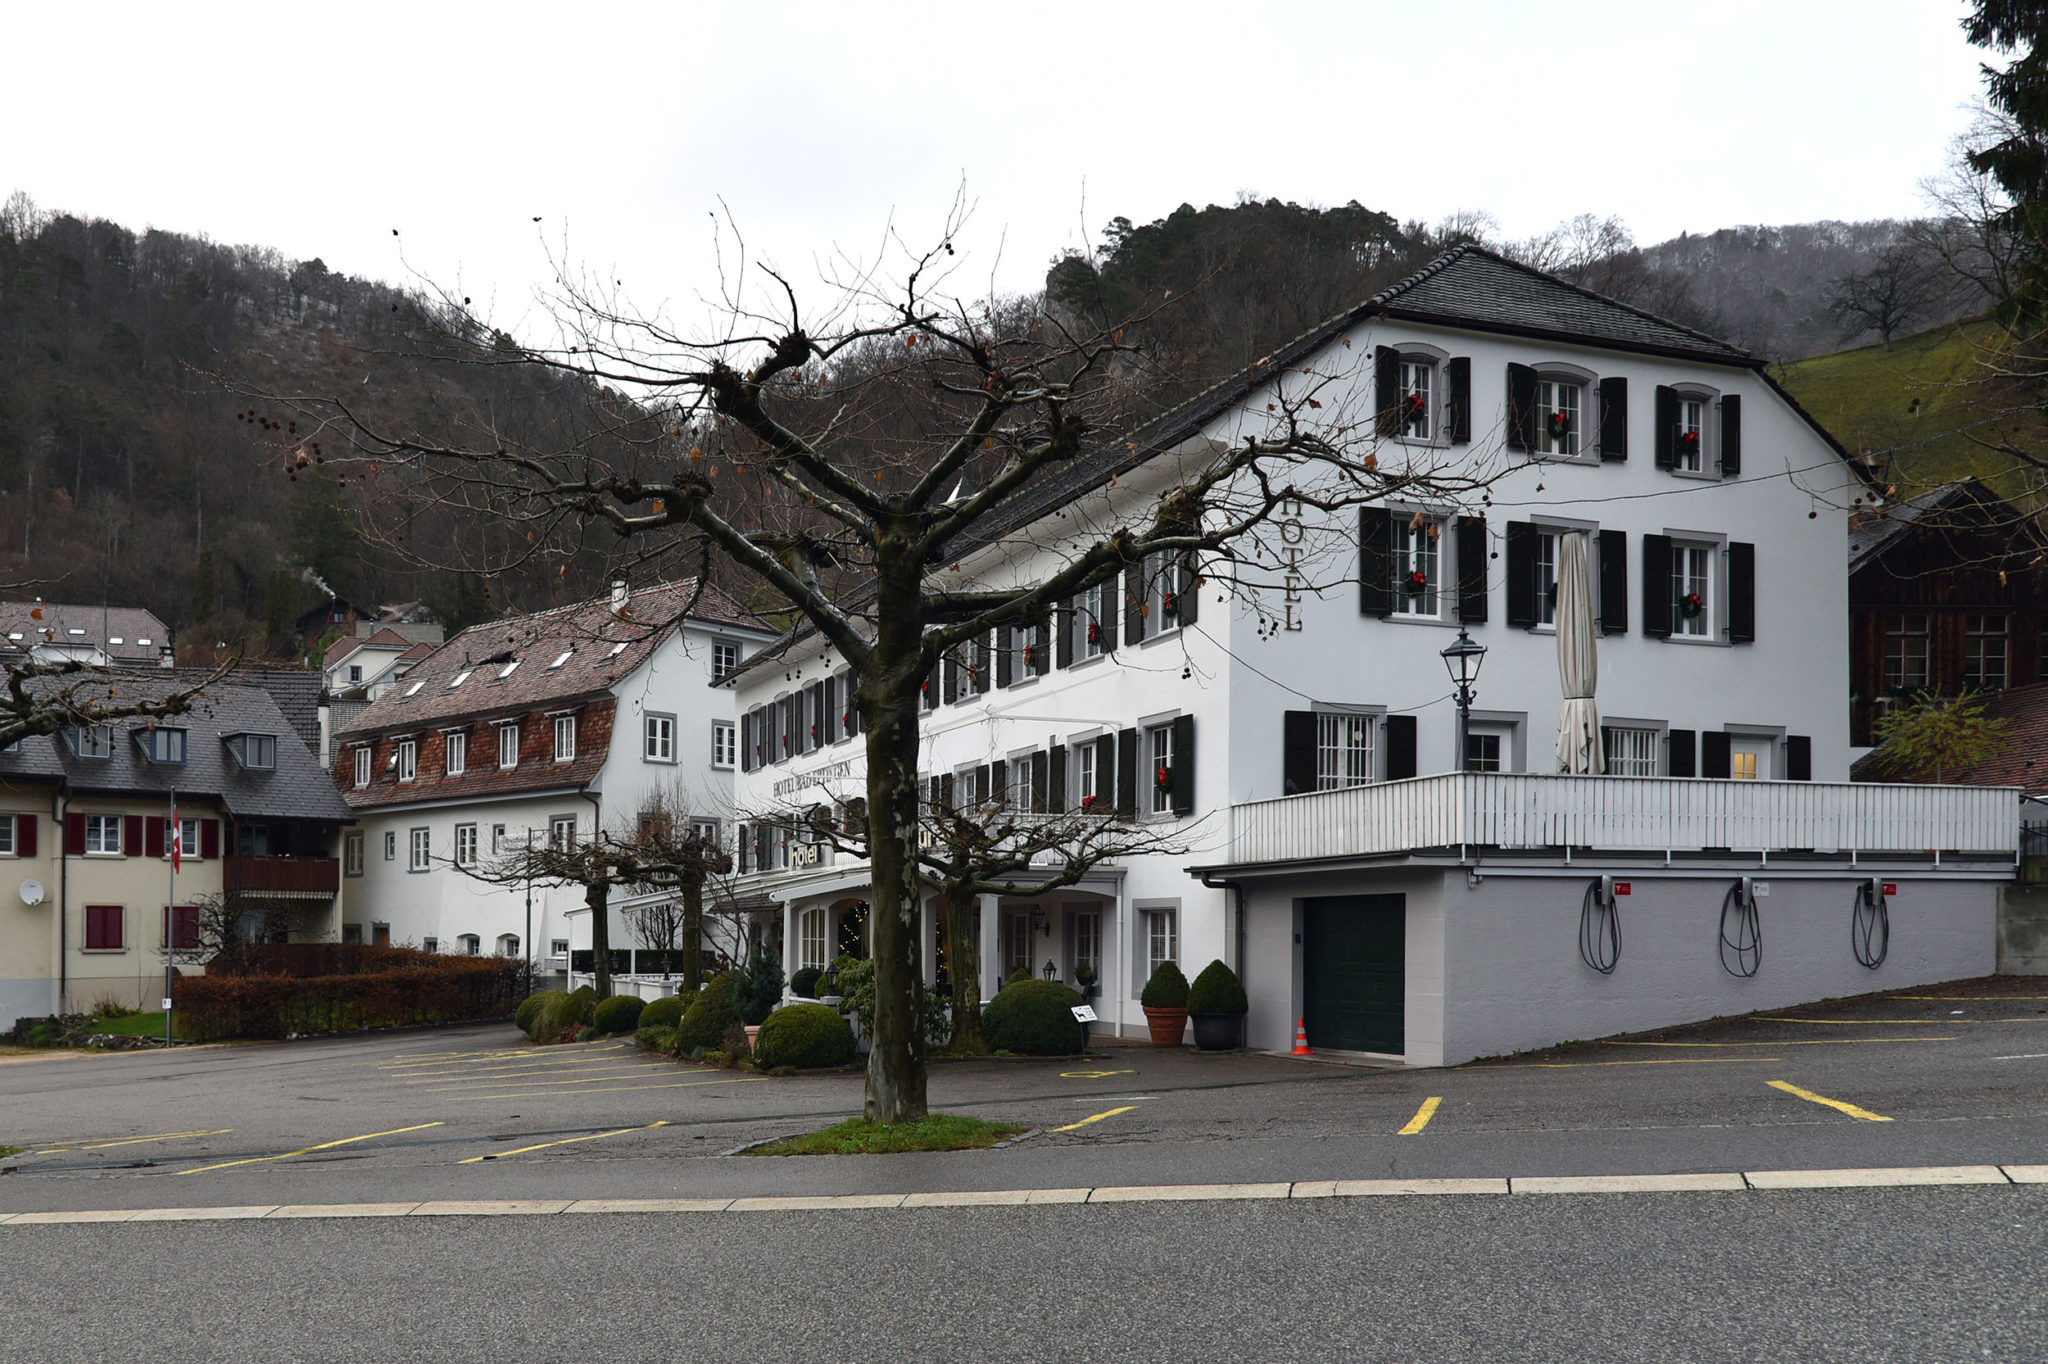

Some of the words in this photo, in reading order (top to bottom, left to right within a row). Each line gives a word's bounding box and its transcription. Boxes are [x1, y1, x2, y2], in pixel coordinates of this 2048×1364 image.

[1281, 490, 1304, 632] HOTEL
[773, 777, 795, 797] HOTEL
[792, 844, 817, 866] hotel
